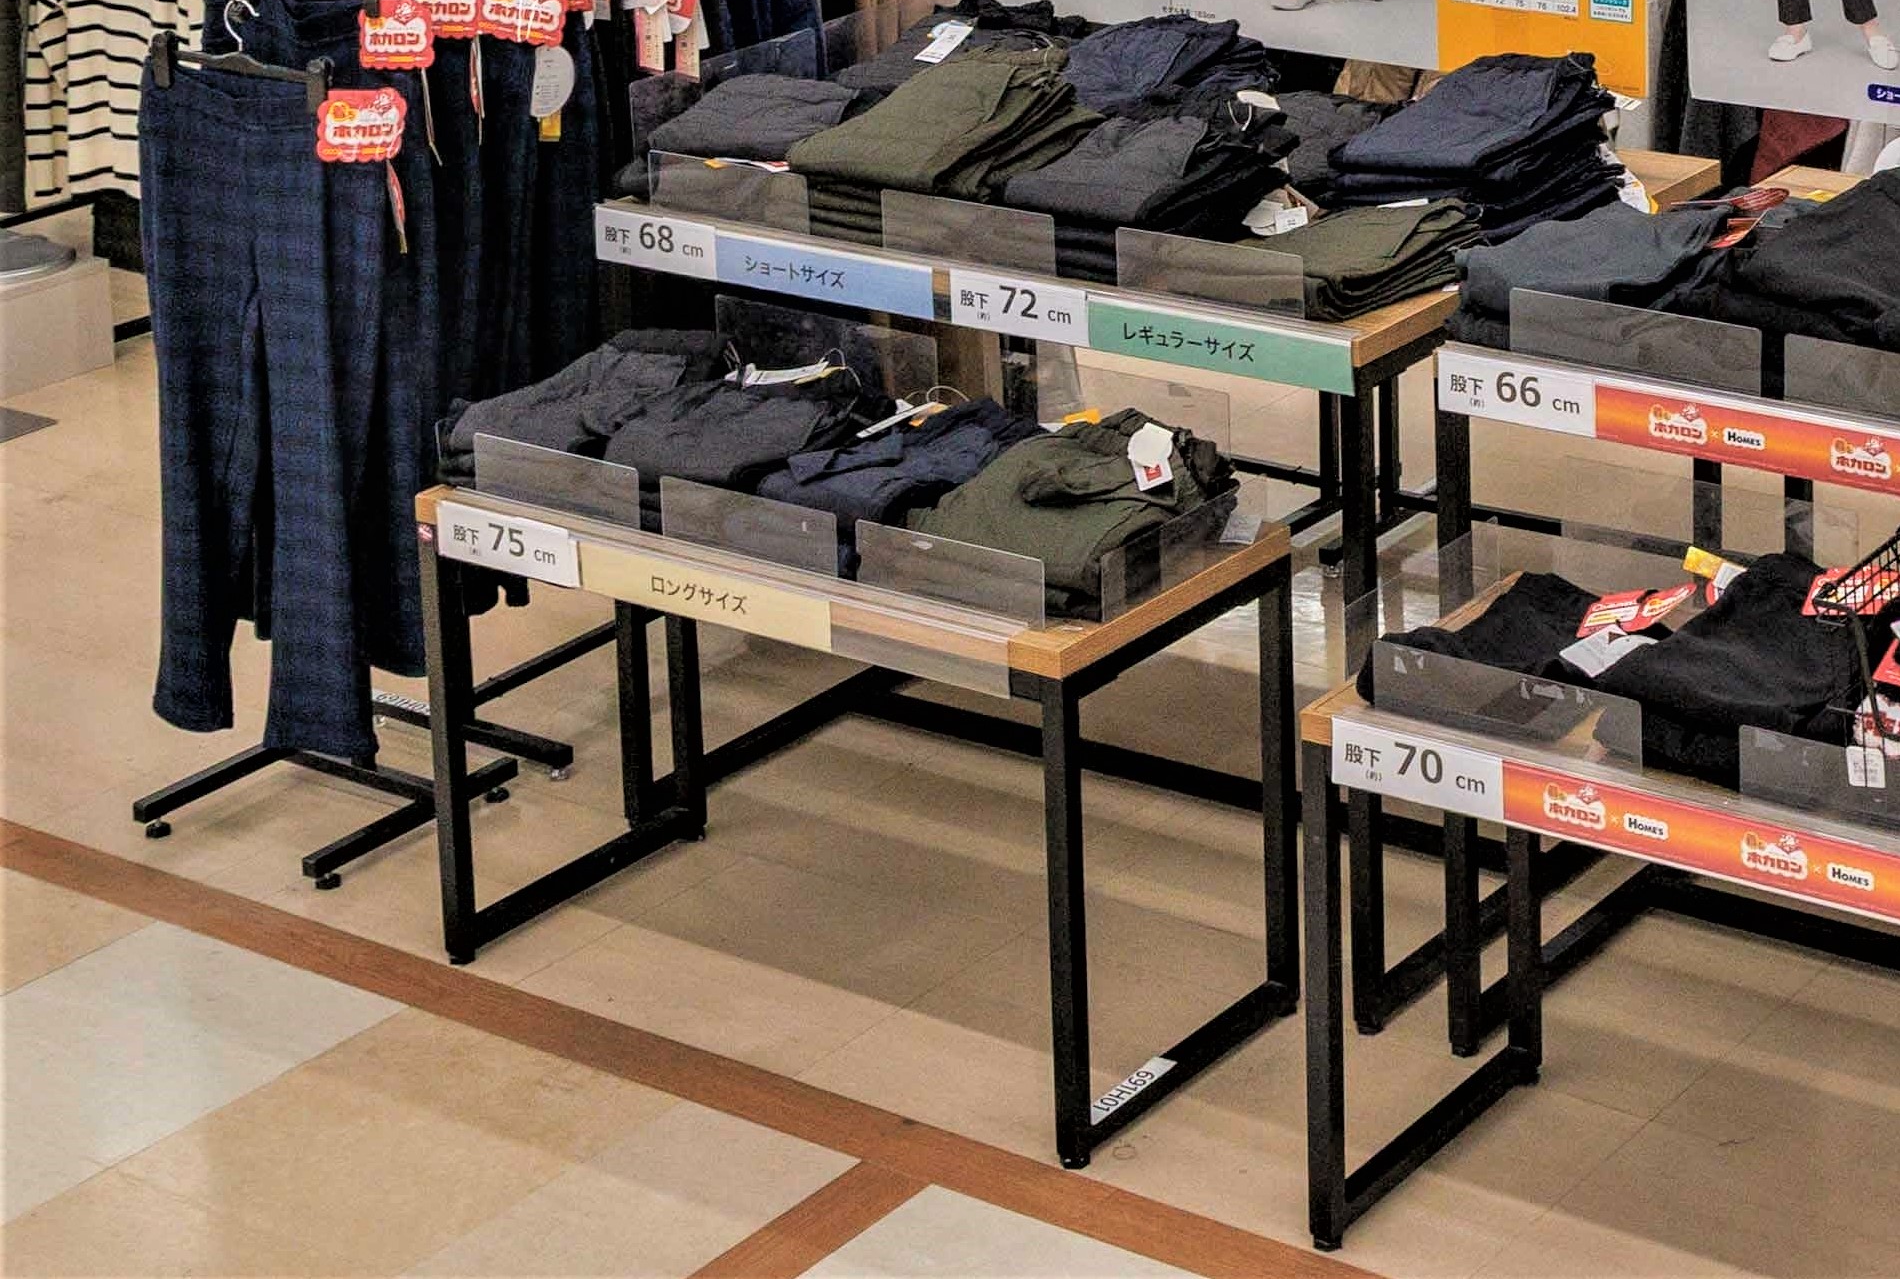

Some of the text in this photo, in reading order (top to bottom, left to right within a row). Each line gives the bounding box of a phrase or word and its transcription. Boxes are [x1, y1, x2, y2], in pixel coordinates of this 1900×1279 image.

[604, 222, 846, 289] 股下 68 cm ショートサイズ
[960, 285, 1256, 363] 股下 72 cm レギュラーサイズ
[1450, 371, 1581, 415] 股下 66 cm
[1653, 422, 1705, 440] ホカロン
[1835, 455, 1889, 475] ホカロン
[452, 522, 748, 614] 股下 75 cm ロングサイズ
[1345, 741, 1486, 795] 股下 70 cm
[1548, 802, 1602, 825] ホカロン
[1747, 851, 1803, 874] ホカロン
